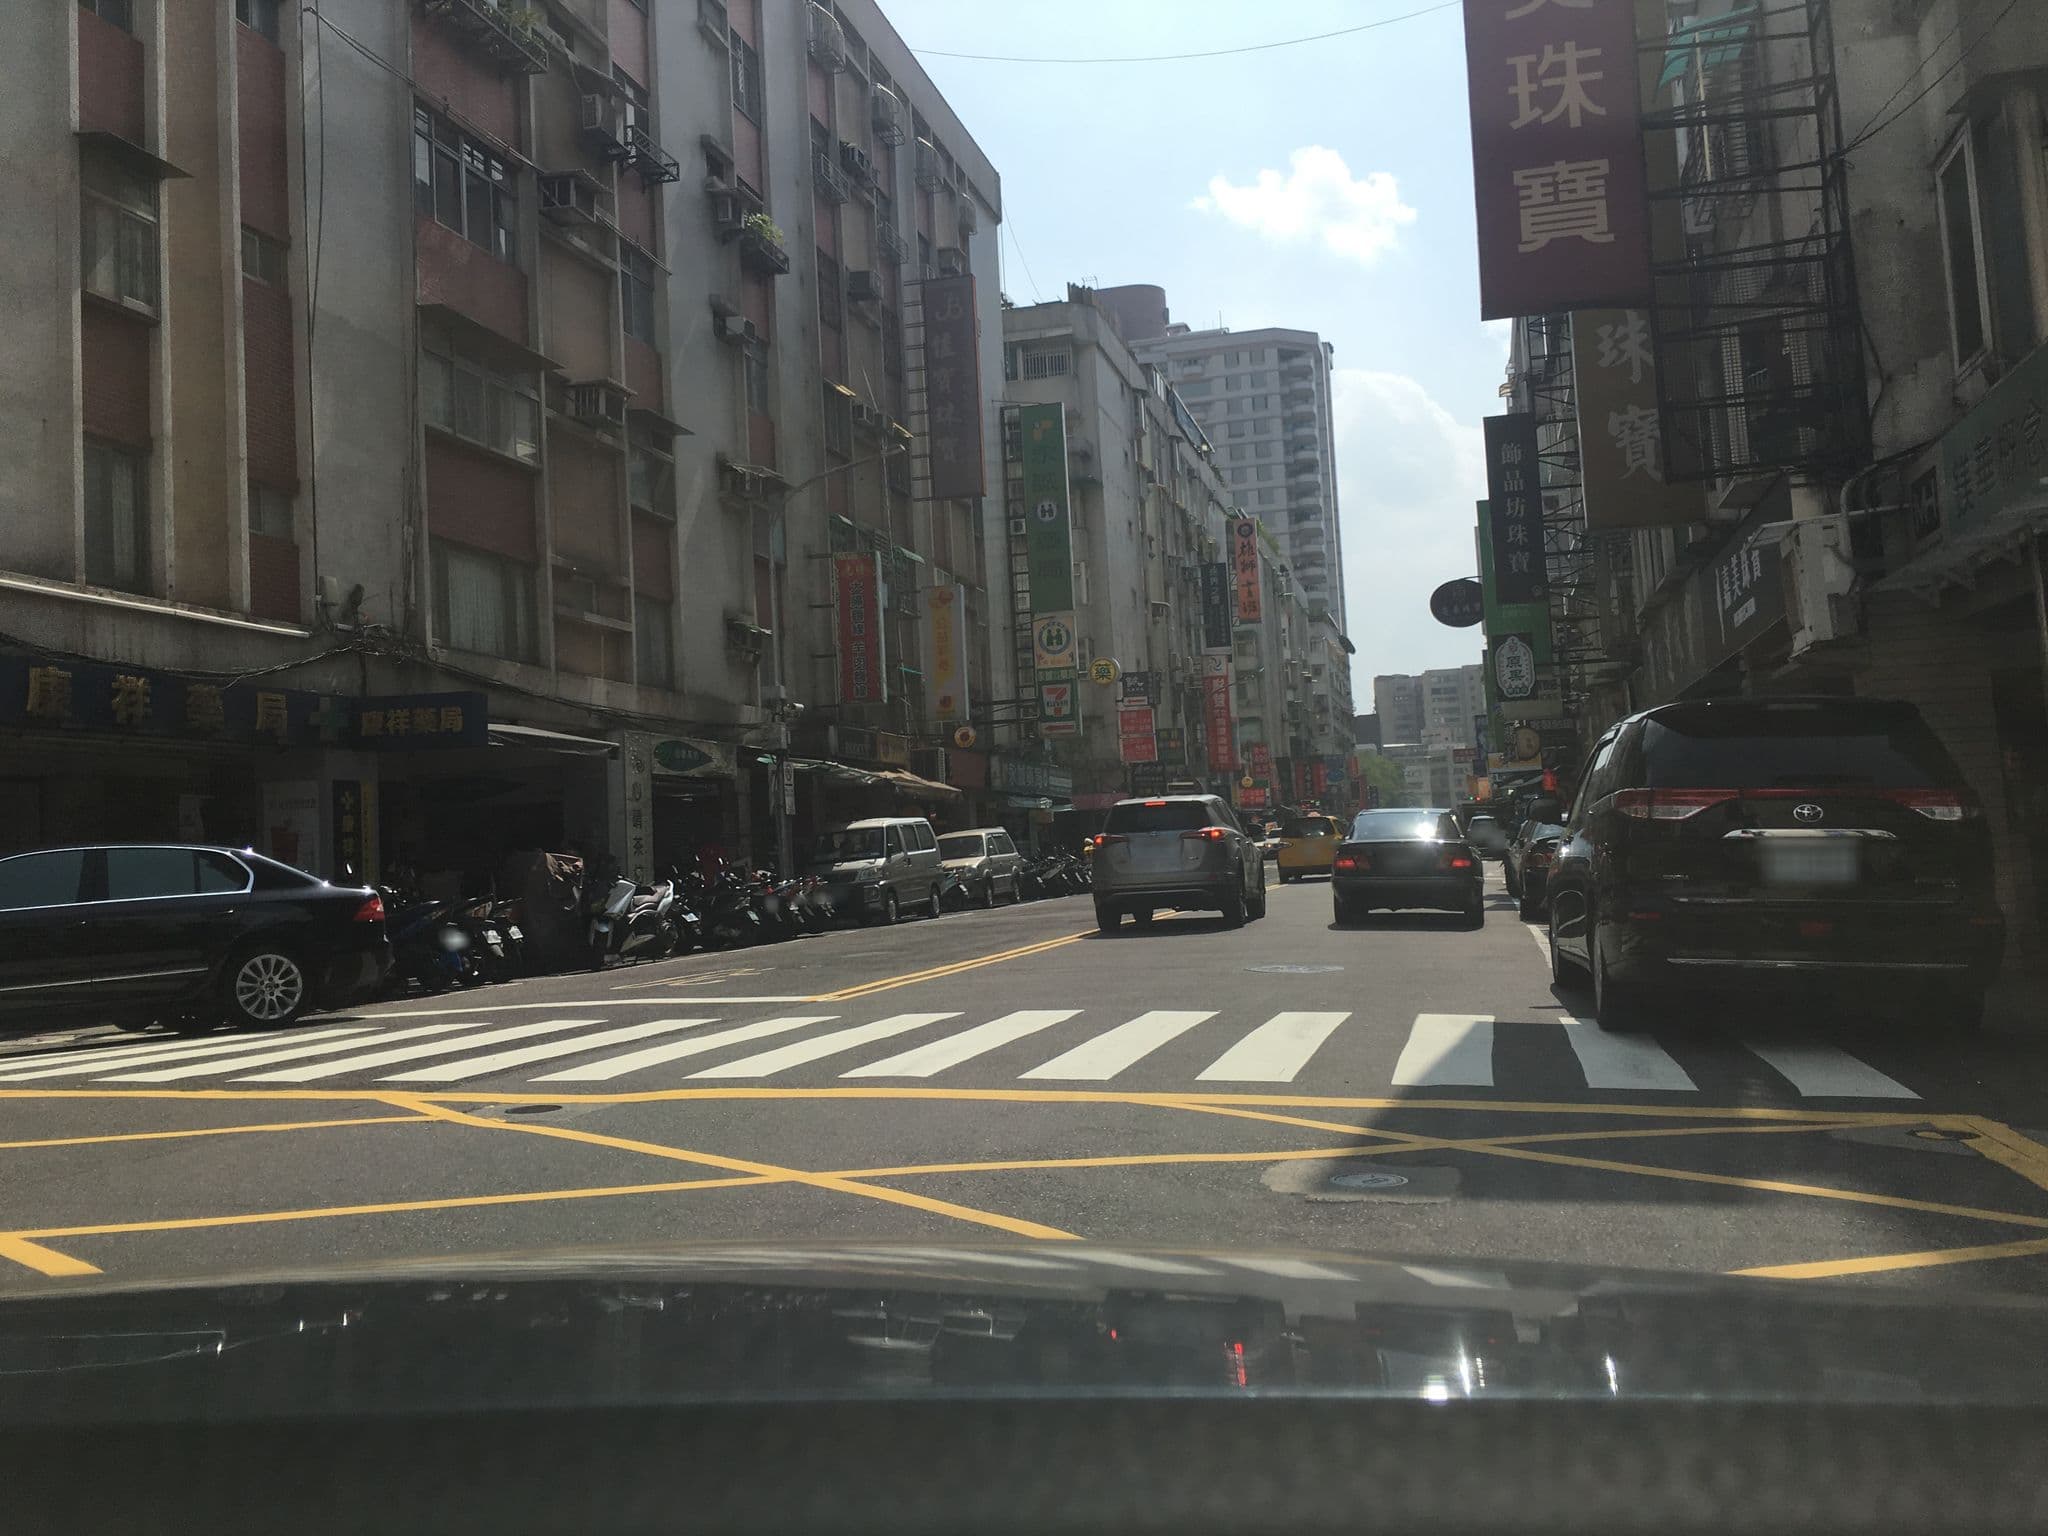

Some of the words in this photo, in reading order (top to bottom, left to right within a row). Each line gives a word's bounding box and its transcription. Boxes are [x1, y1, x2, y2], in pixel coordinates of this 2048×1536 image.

[1500, 443, 1530, 575] 飾品坊珠寶
[1094, 662, 1112, 681] 藥
